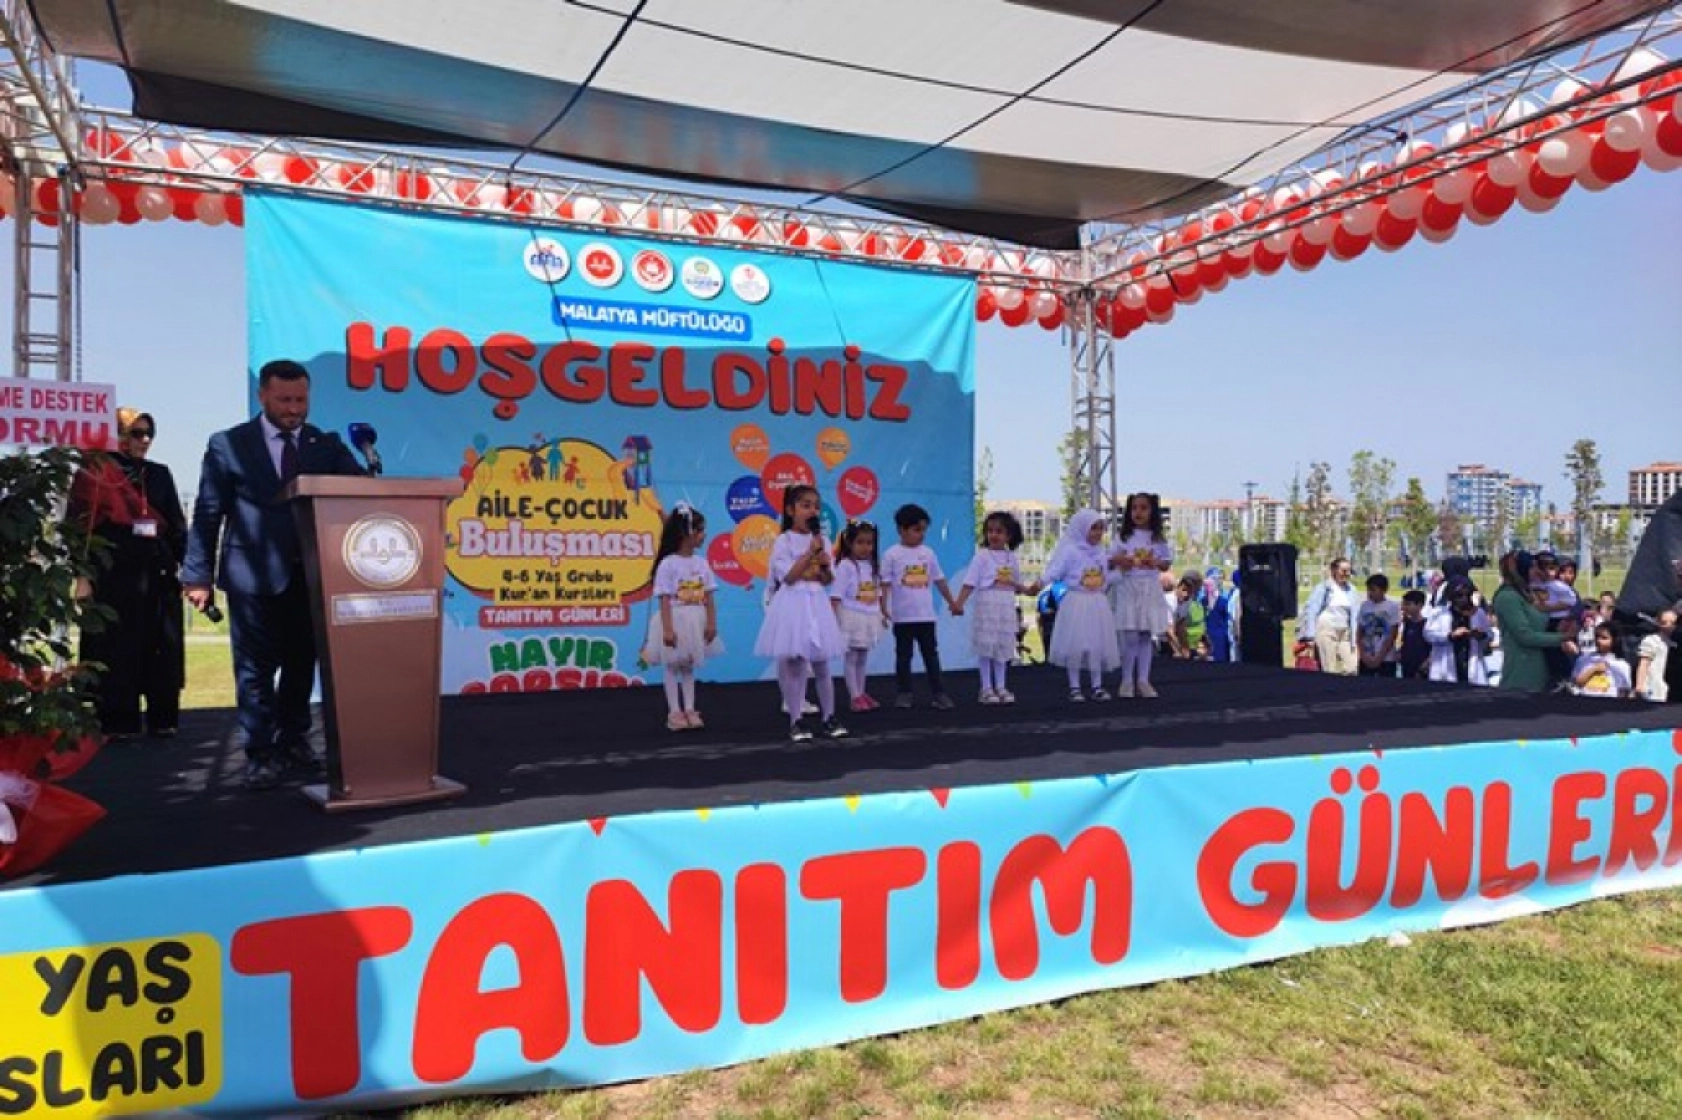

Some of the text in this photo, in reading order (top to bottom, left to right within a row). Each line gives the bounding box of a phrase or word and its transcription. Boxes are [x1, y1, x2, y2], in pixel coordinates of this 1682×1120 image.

[559, 302, 638, 326] MALATYA
[345, 321, 911, 420] HOŞGELDİNİZ
[30, 388, 108, 413] DESTEK
[477, 490, 628, 524] AİLE-ÇOCUK
[459, 519, 655, 566] Buluşması
[535, 569, 561, 585] Yaş
[567, 569, 613, 583] Grubu
[485, 604, 625, 623] TANITIM GÜNLERİ
[490, 636, 615, 672] HAYIR
[230, 825, 1132, 1100] TANITIM
[33, 941, 192, 1025] YAŞ
